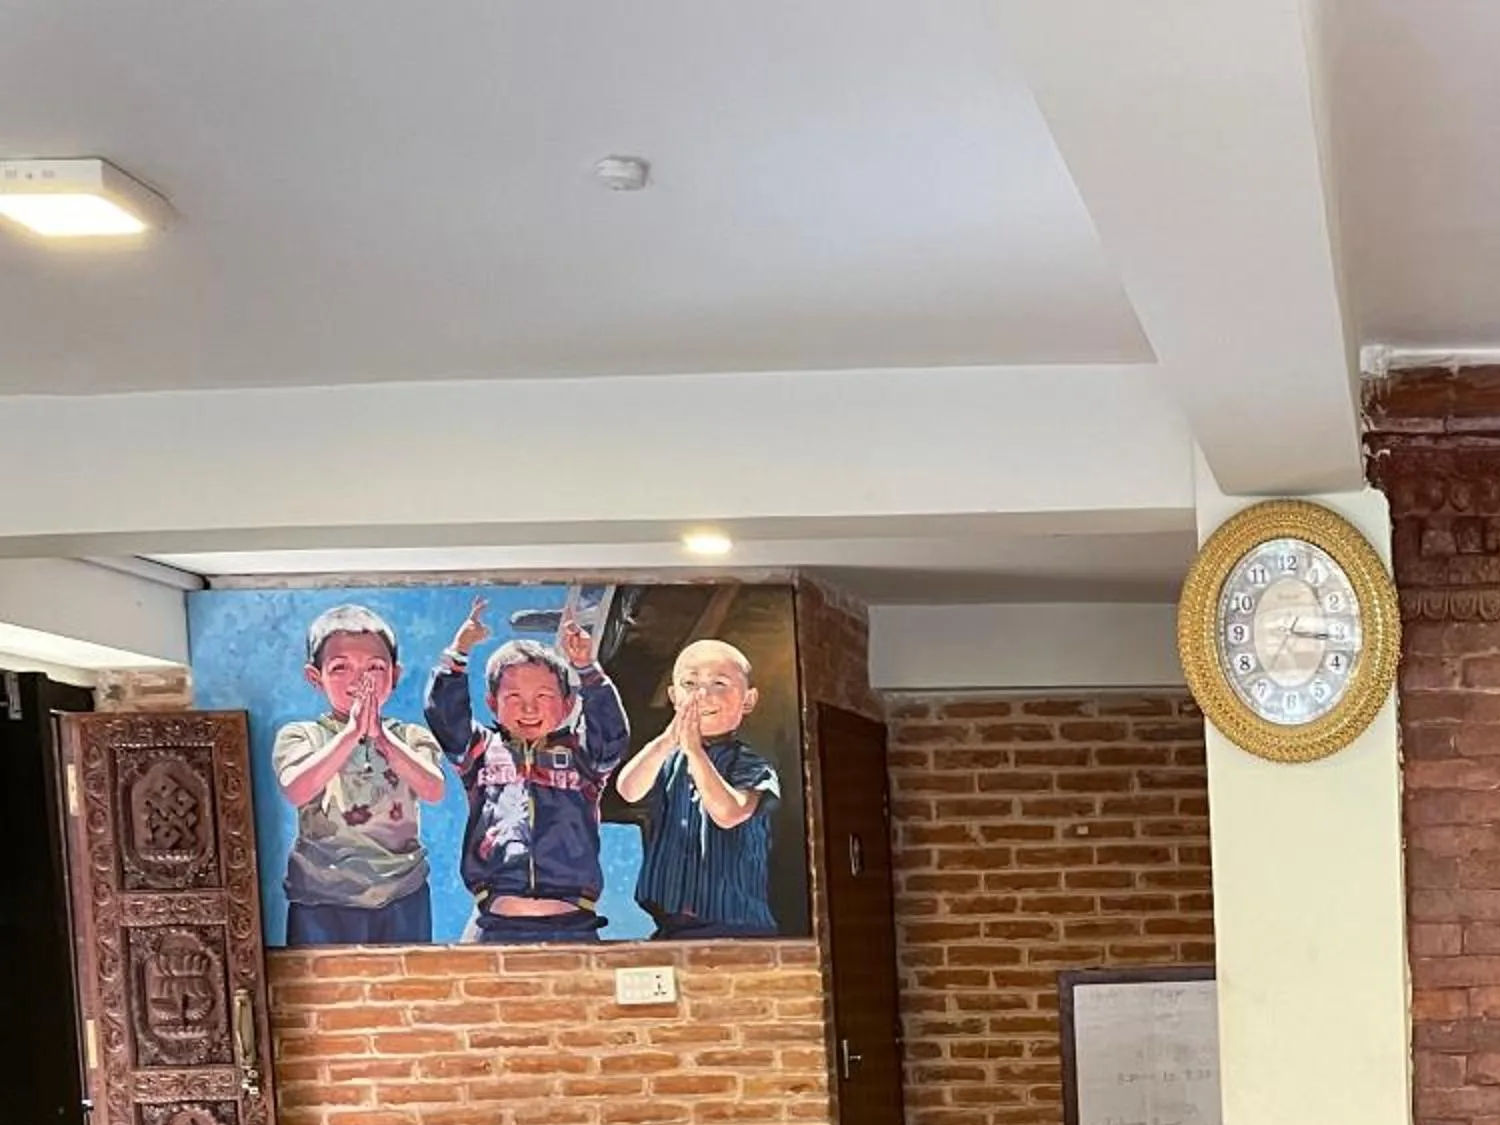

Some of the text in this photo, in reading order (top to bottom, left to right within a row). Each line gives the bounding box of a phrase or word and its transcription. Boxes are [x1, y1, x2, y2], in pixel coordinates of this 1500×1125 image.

[1280, 555, 1297, 572] 12
[1250, 569, 1266, 585] 11
[1311, 568, 1321, 585] 1
[1233, 595, 1253, 612] 10
[1329, 594, 1339, 610] 2
[1233, 626, 1244, 642] 9
[1333, 625, 1344, 641] 3
[1240, 655, 1250, 671] 8
[1331, 653, 1342, 669] 4
[1256, 682, 1268, 698] 7
[1315, 682, 1325, 699] 5
[1286, 692, 1297, 709] 6
